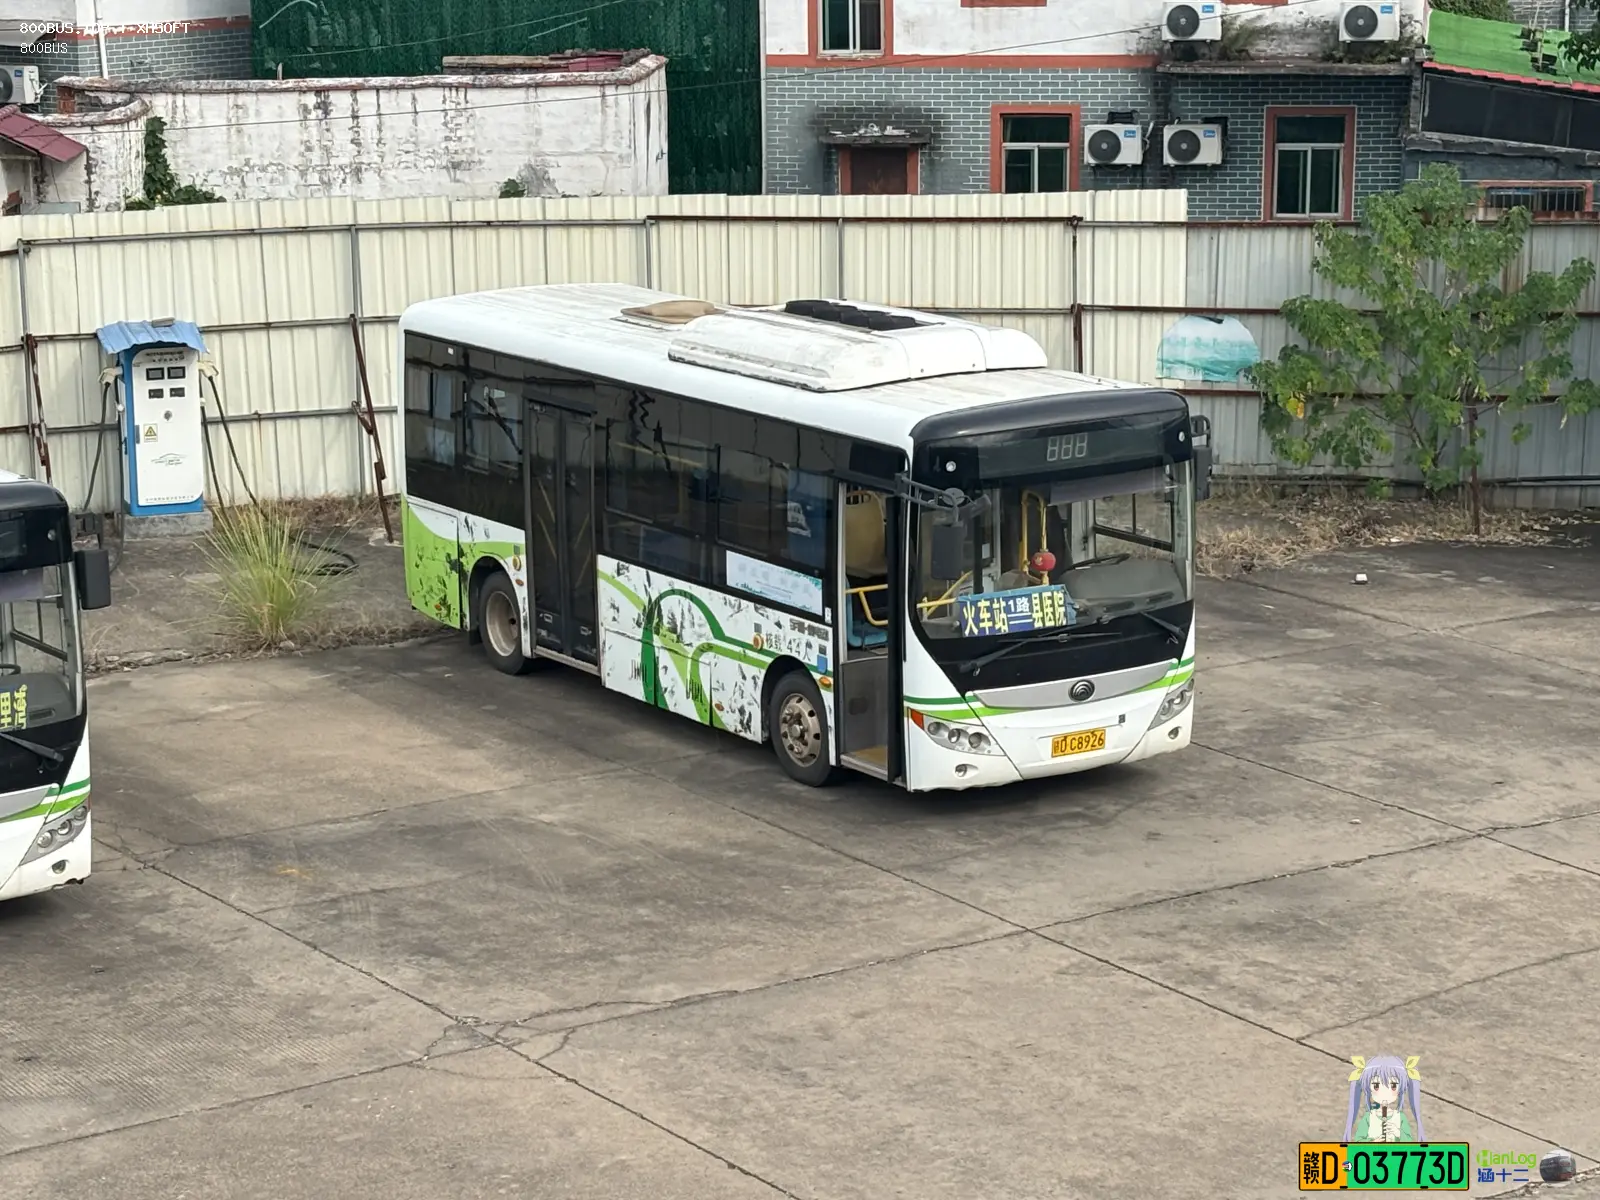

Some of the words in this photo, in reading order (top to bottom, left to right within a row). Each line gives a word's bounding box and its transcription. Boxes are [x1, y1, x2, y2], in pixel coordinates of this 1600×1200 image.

[962, 597, 1009, 637] 火车站
[1007, 597, 1030, 612] 1路
[1031, 590, 1067, 628] 县医院
